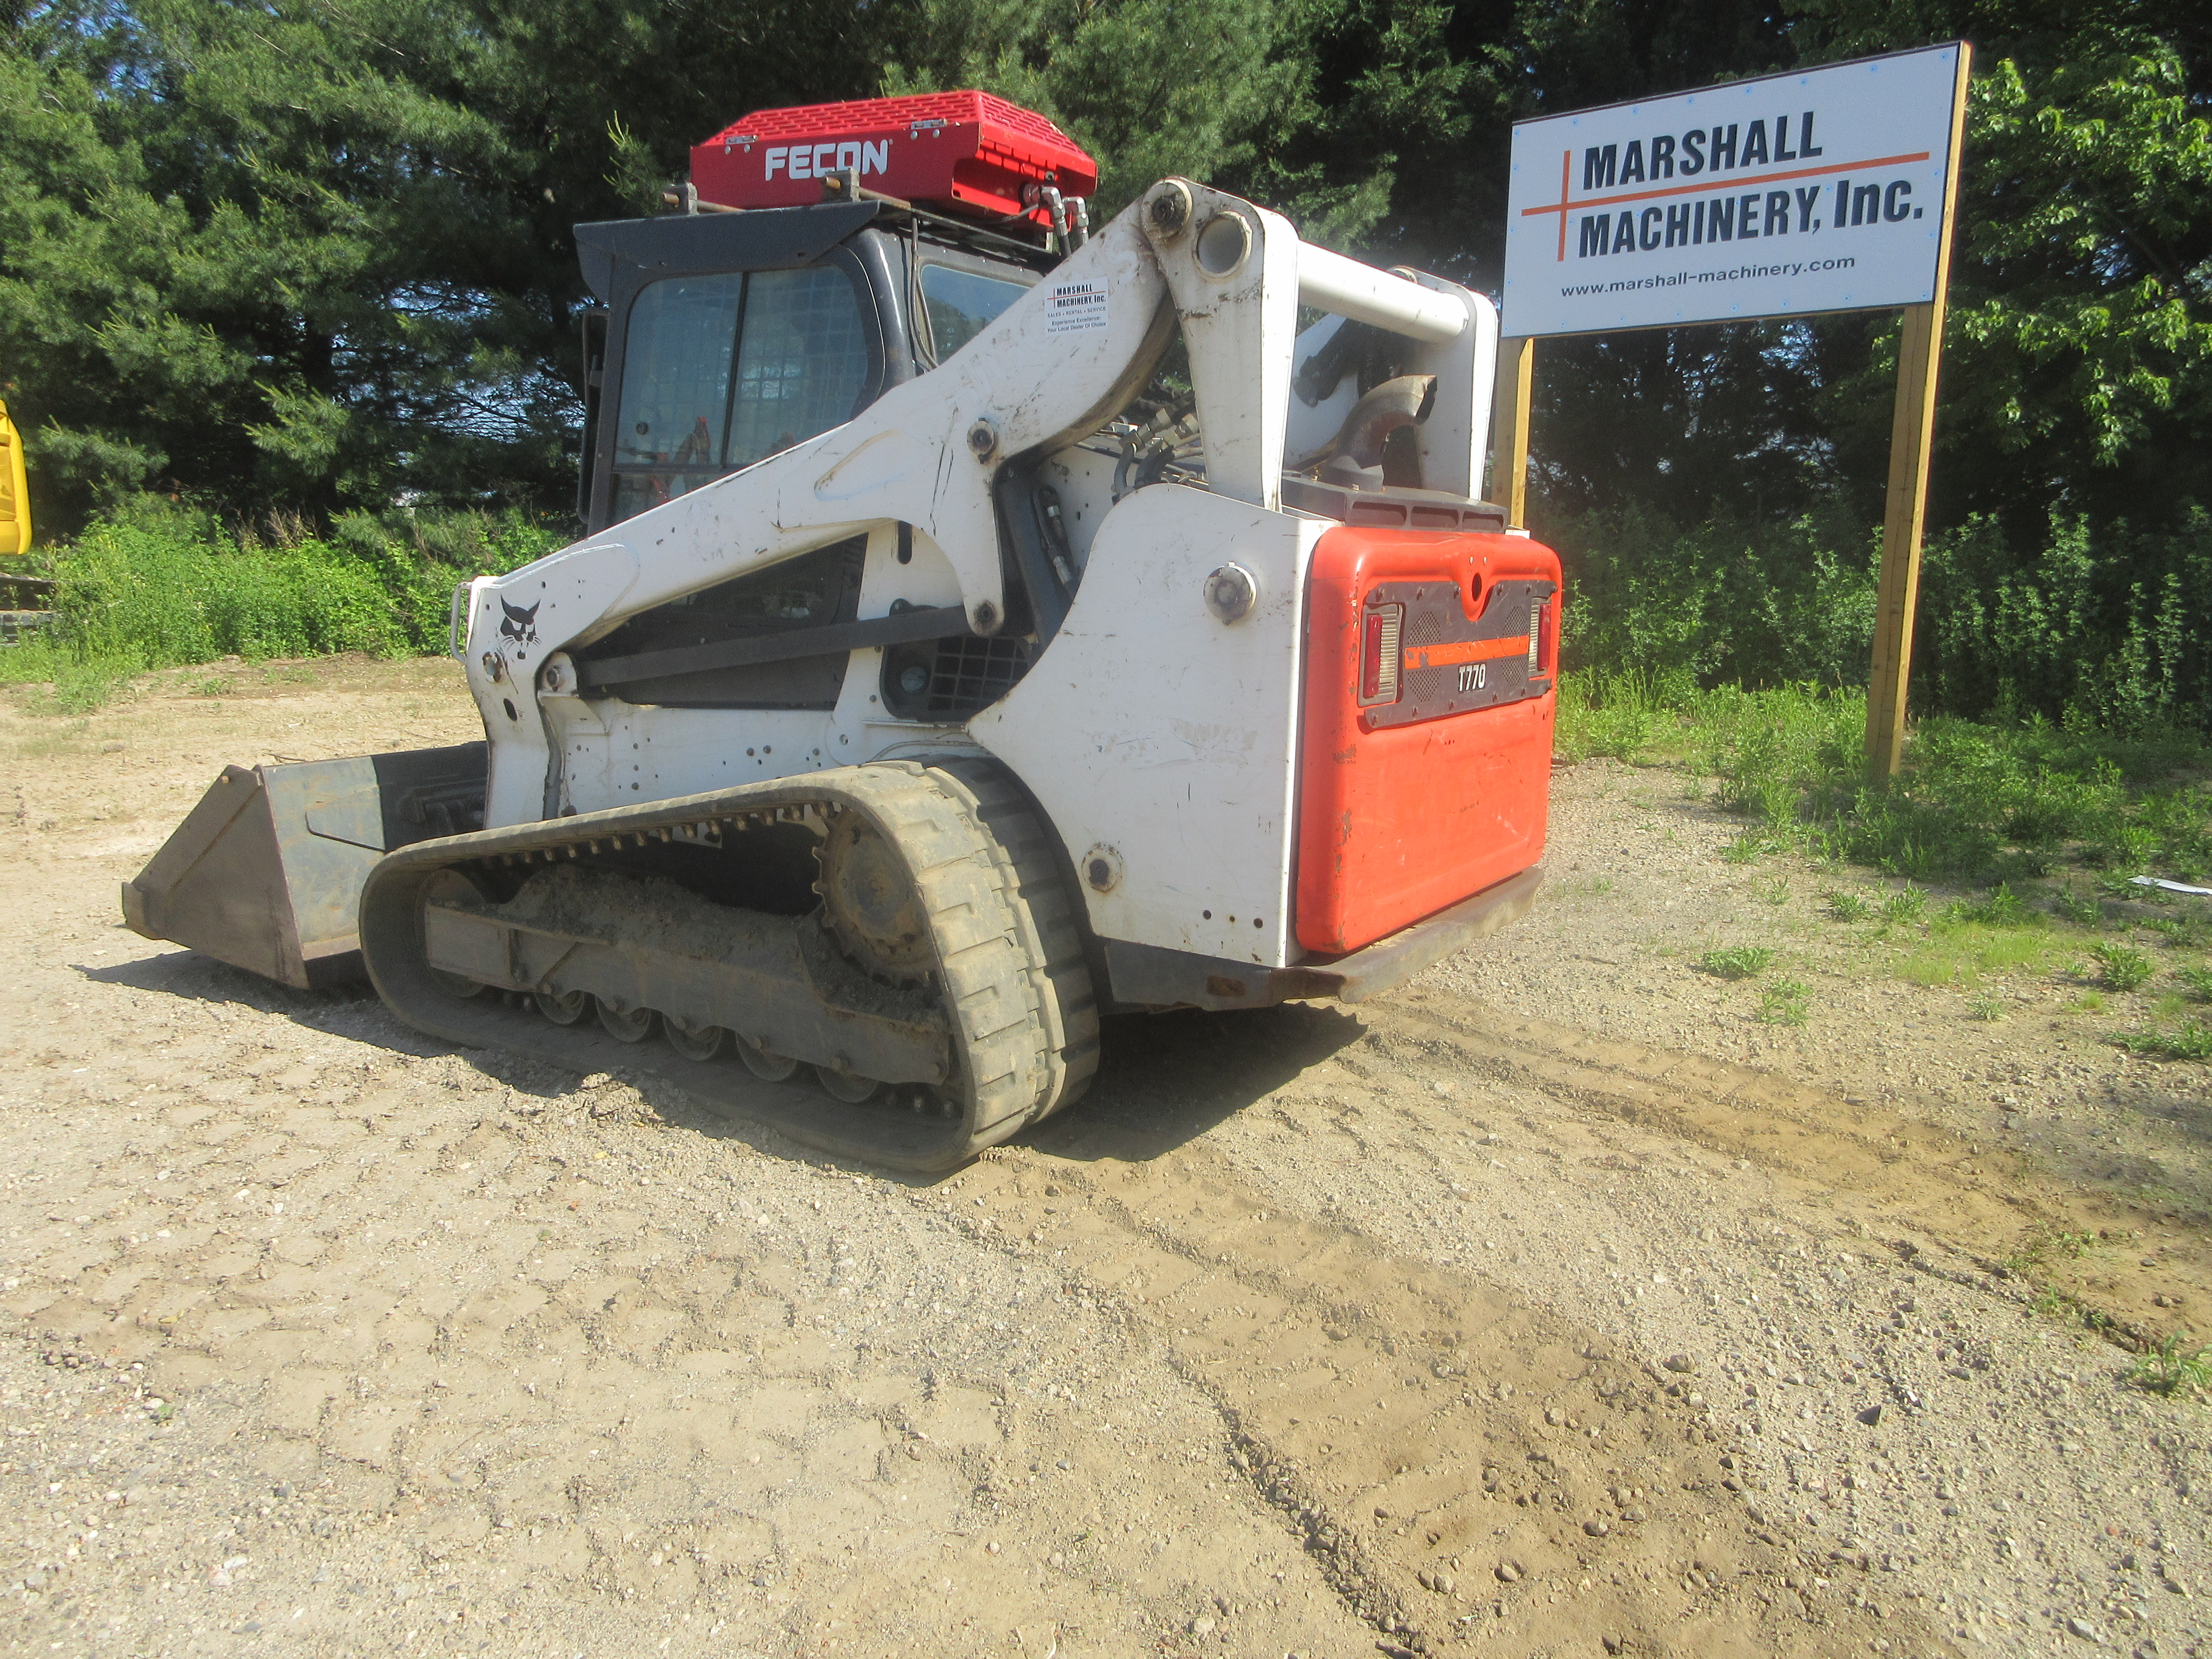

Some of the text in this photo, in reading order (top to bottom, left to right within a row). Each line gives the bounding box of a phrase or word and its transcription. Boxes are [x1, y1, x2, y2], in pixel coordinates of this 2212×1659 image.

[765, 139, 888, 180] FECON
[1583, 111, 1822, 191] MARSHALL
[1578, 179, 1924, 258] MACHINERY, Inc.
[1057, 284, 1092, 296] MARSHALL
[1560, 256, 1855, 297] www.marshall-machinery.com
[1057, 294, 1106, 308] MACHINERY, Inc.
[1458, 663, 1486, 692] T770
